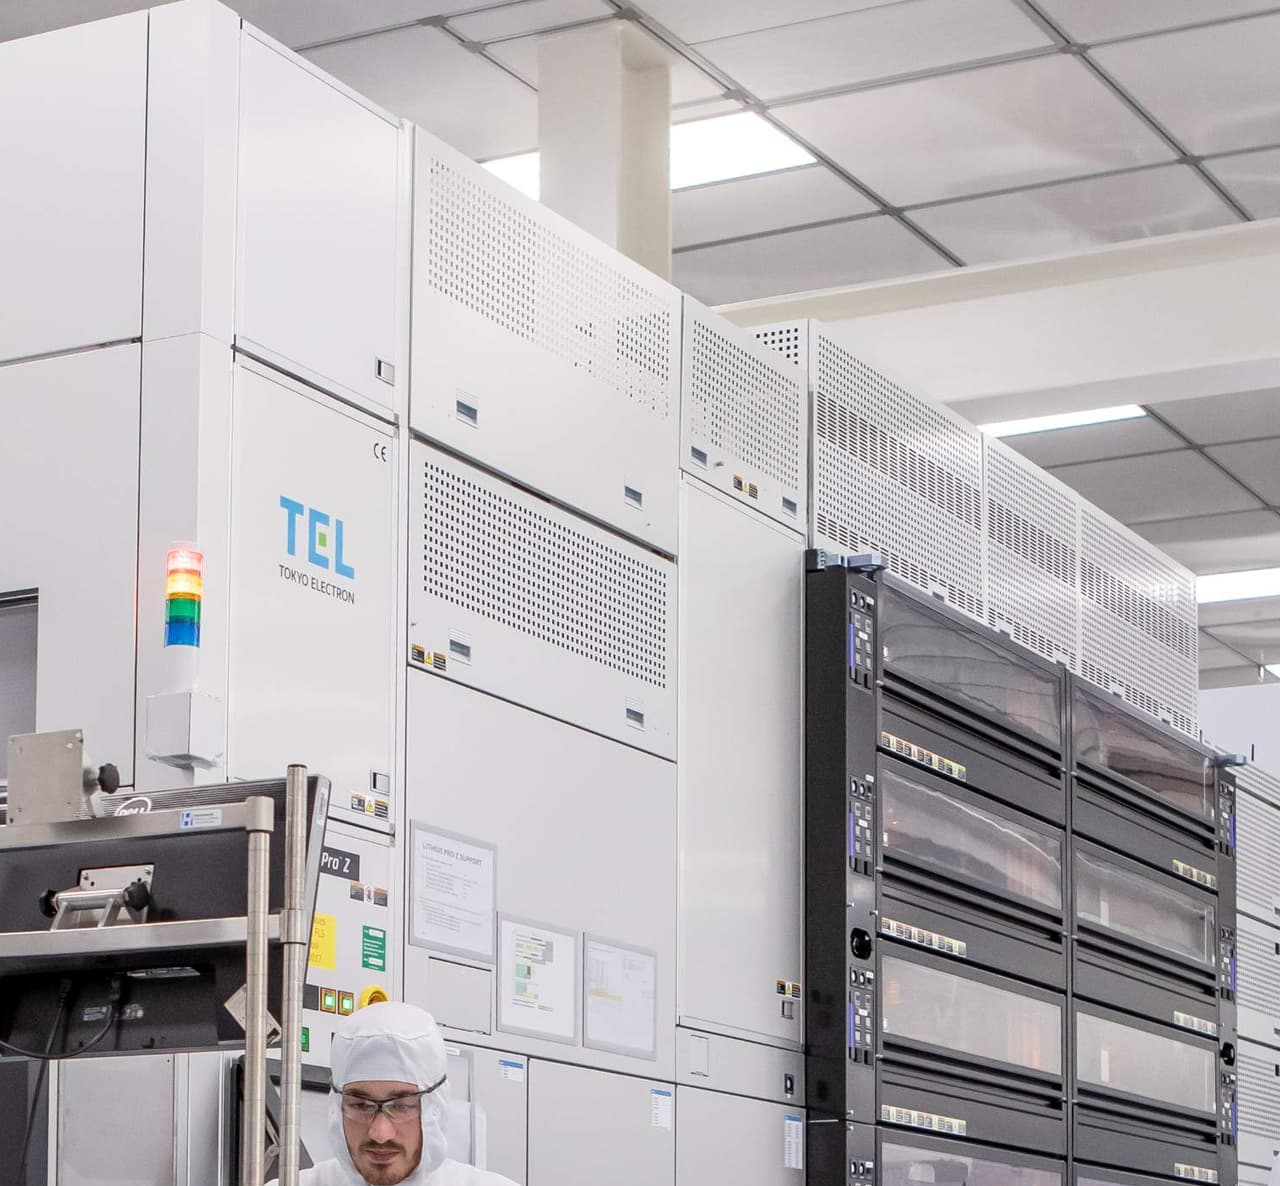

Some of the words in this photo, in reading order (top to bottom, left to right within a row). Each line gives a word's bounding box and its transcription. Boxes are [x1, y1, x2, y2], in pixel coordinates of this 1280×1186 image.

[279, 495, 355, 580] TEL
[278, 564, 310, 586] TOKYO
[310, 576, 355, 605] ELECTRON
[320, 851, 340, 870] Pro
[342, 856, 352, 873] Z
